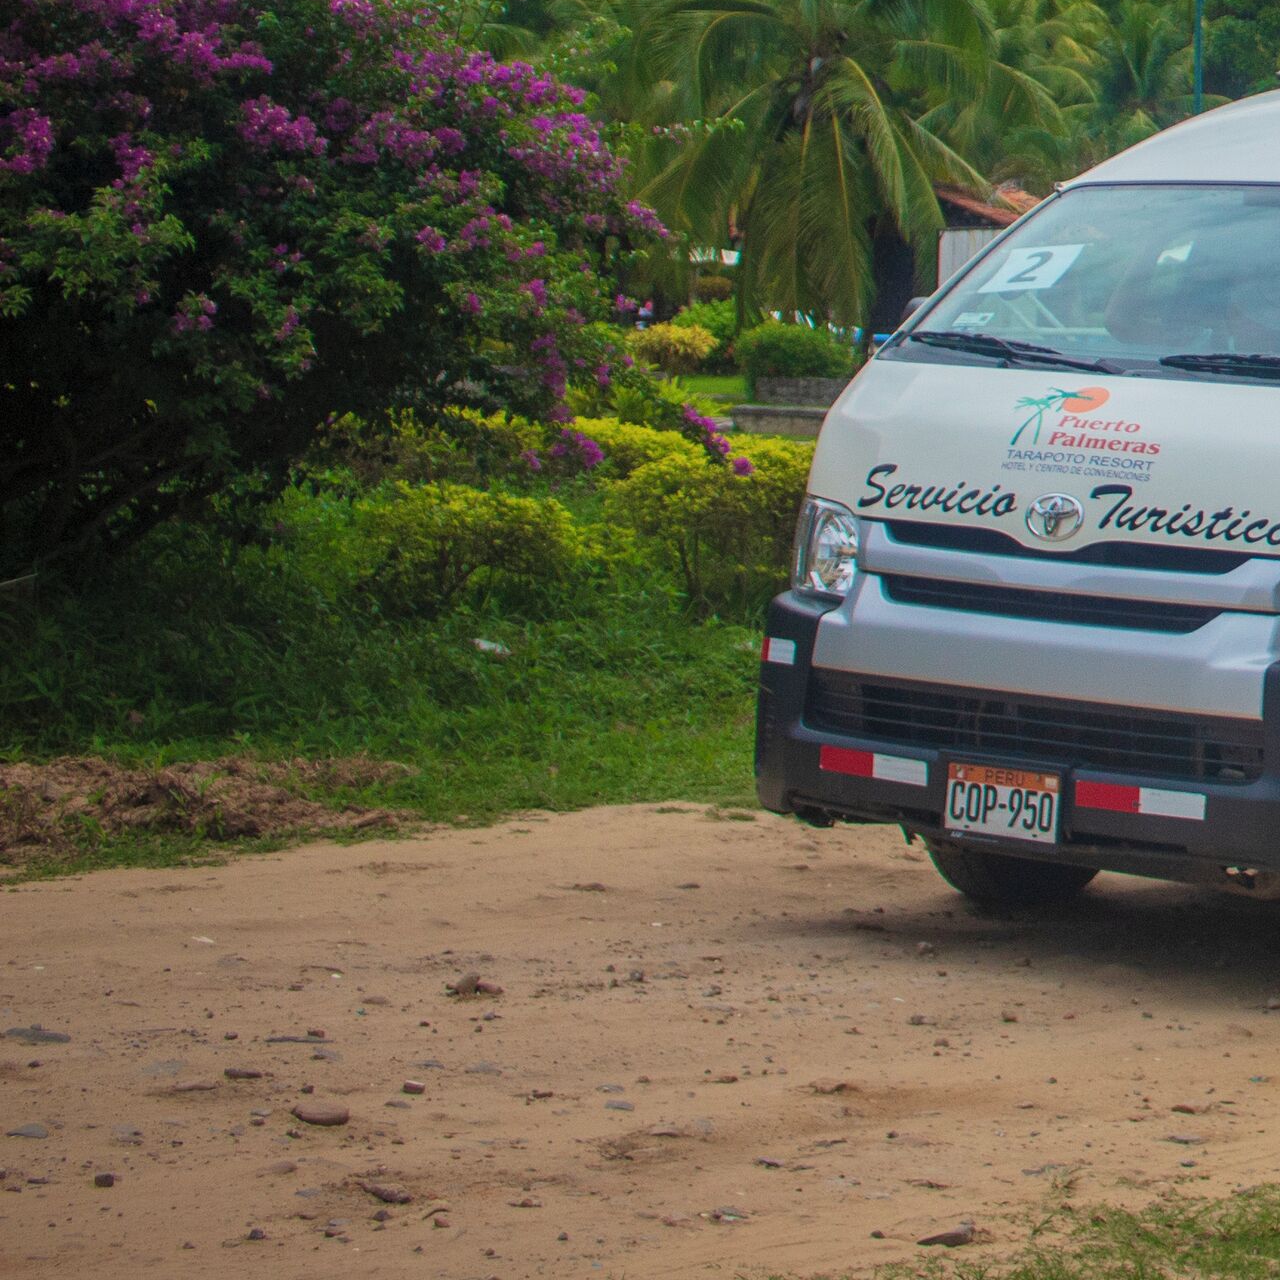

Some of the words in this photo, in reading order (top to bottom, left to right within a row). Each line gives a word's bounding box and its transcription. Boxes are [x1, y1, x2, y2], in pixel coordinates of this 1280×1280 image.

[1007, 250, 1053, 283] 2
[1057, 415, 1141, 433] Puerto
[1047, 431, 1161, 455] Palmeras
[1007, 449, 1085, 464] TARAPOTO
[1089, 455, 1155, 471] RESORT
[1001, 462, 1026, 471] HOTEL
[1028, 462, 1034, 471] Y
[1035, 464, 1067, 474] CENTRO
[1069, 466, 1081, 475] DE
[1083, 467, 1151, 482] CONVENCIONES
[858, 464, 1017, 517] Servicio
[984, 768, 1025, 786] PERU
[950, 780, 1054, 832] COP-950
